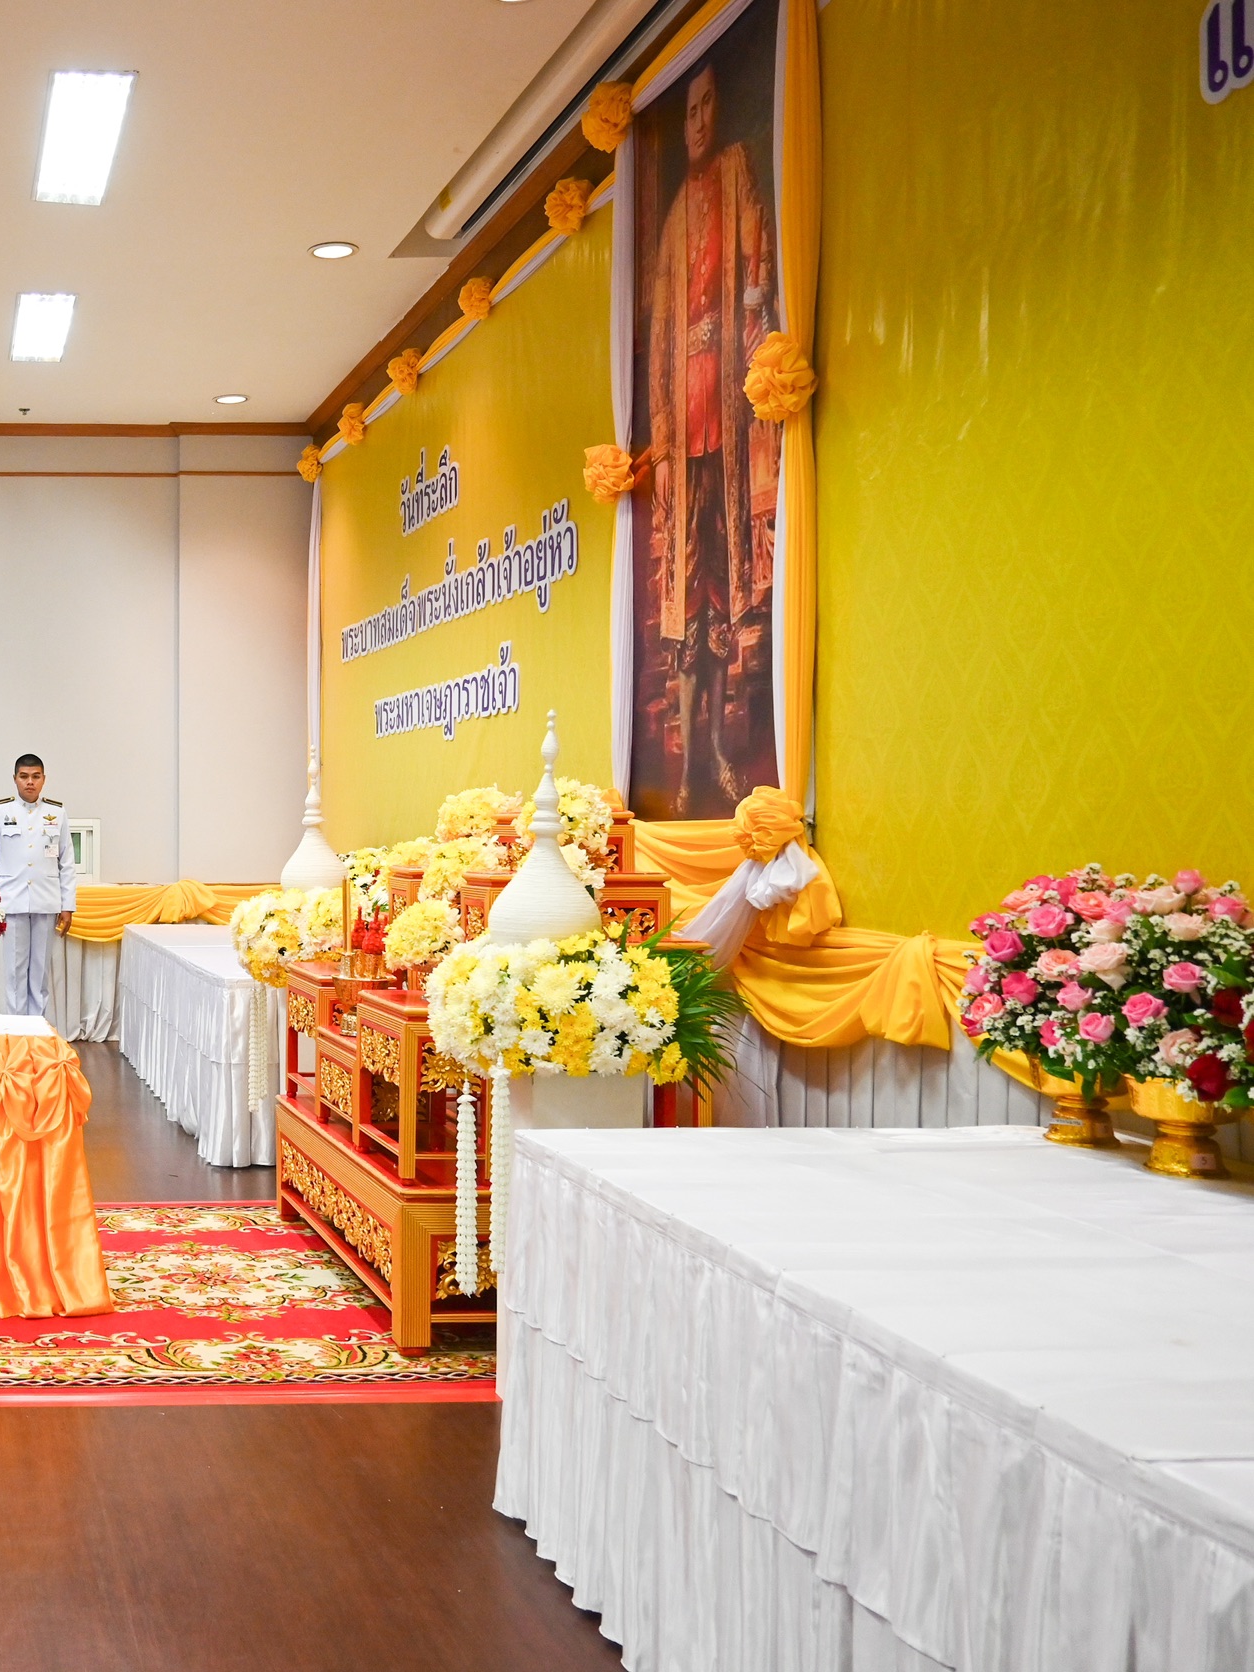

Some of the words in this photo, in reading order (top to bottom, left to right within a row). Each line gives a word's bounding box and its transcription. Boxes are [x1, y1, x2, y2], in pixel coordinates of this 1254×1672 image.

[399, 448, 458, 534] วันที่ระลึก
[341, 502, 575, 660] พระบาทสมเด็จพระนั่งเกล้าเจ้าอยู่หัว
